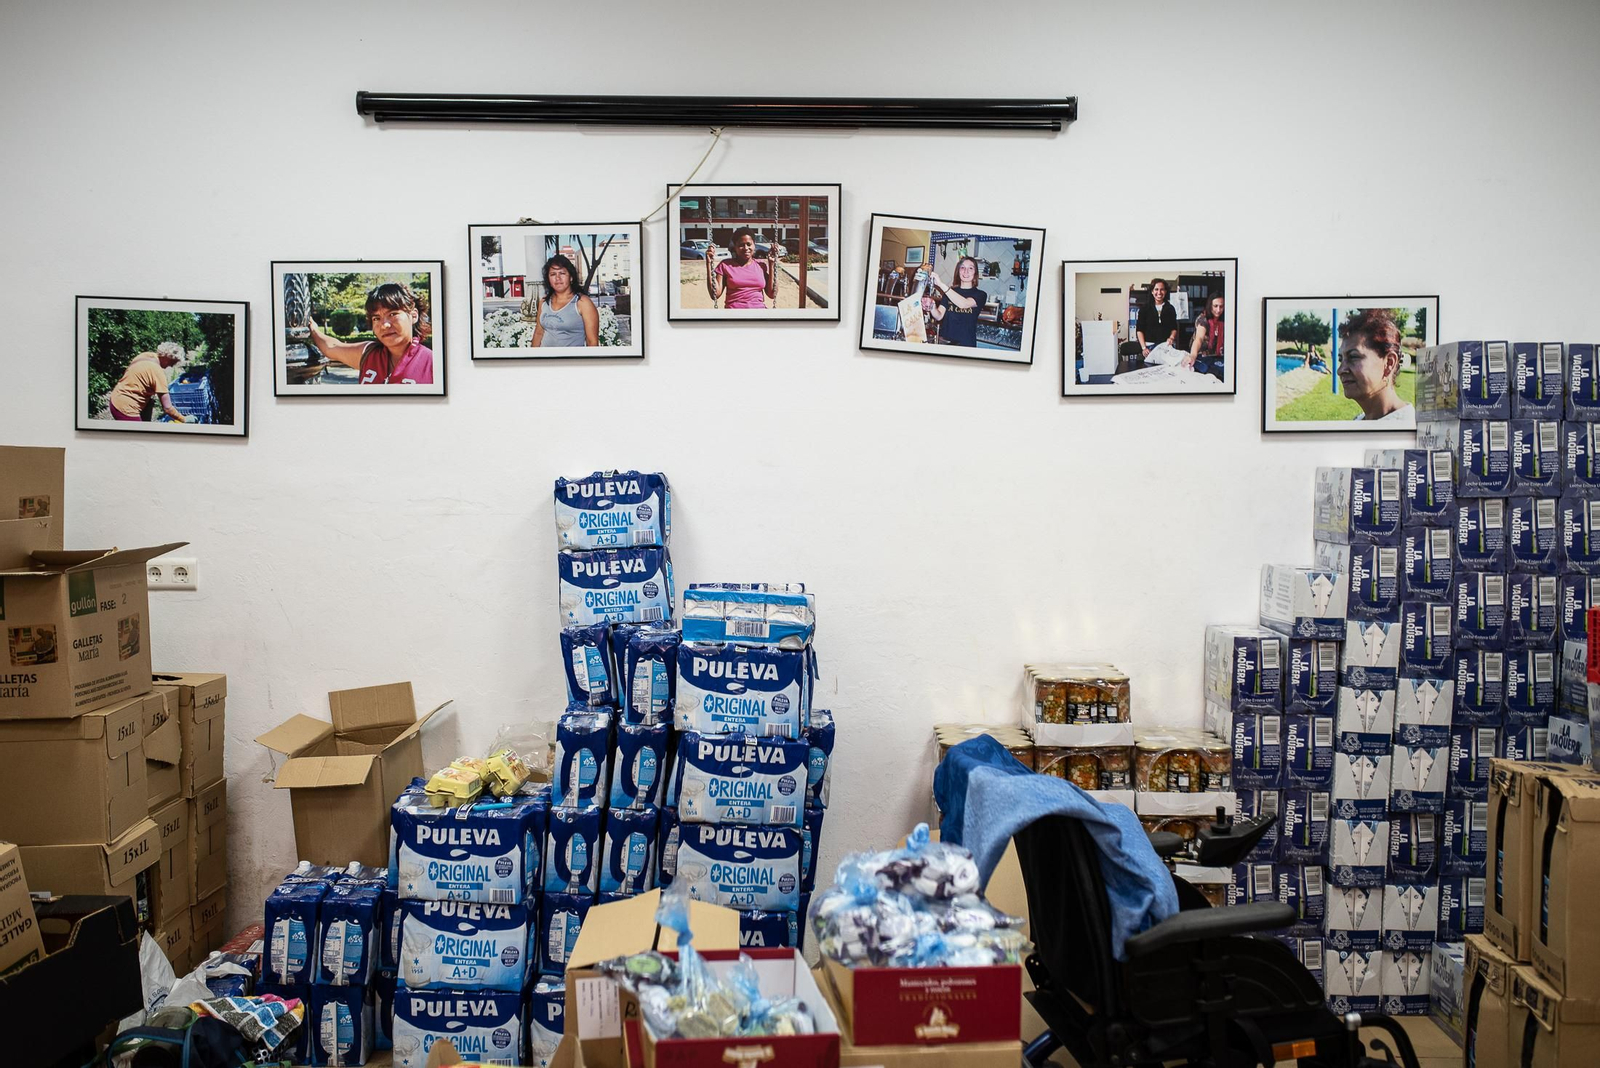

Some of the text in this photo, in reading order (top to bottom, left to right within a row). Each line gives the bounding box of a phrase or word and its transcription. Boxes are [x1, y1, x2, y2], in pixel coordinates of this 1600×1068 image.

[1462, 352, 1471, 389] VAQUERA
[1471, 366, 1479, 375] LA
[1517, 353, 1526, 391] VAQUERA
[1526, 367, 1534, 377] LA
[1572, 355, 1582, 391] VAQUERA
[1581, 368, 1589, 378] LA
[1463, 429, 1472, 467] VAQUERA
[1472, 443, 1480, 453] LA
[1513, 430, 1523, 468] VAQUERA
[1522, 444, 1531, 454] LA
[1567, 431, 1576, 469] VAQUERA
[1576, 445, 1584, 455] LA
[1408, 460, 1417, 498] VAQUERA
[1416, 474, 1424, 484] LA
[566, 480, 641, 498] PULEVA
[1353, 479, 1363, 516] VAQUERA
[1362, 492, 1371, 502] LA
[578, 512, 634, 529] ORIGINAL
[1459, 506, 1468, 544] VAQUERA
[1468, 520, 1476, 530] LA
[1512, 507, 1521, 545] VAQUERA
[1521, 521, 1529, 531] LA
[1564, 509, 1573, 547] VAQUERA
[1572, 523, 1581, 533] LA
[596, 534, 618, 545] A+D
[1405, 537, 1414, 573] VAQUERA
[1414, 550, 1422, 560] LA
[571, 557, 647, 578] PULEVA
[1352, 555, 1362, 592] VAQUERA
[1361, 569, 1370, 579] LA
[71, 595, 96, 614] gullón
[122, 593, 127, 604] 2
[585, 589, 641, 608] ORIGINAL
[1458, 583, 1467, 620] VAQUERA
[1467, 597, 1475, 606] LA
[1512, 584, 1521, 621] VAQUERA
[1521, 598, 1529, 607] LA
[1565, 586, 1574, 623] VAQUERA
[1574, 600, 1582, 610] LA
[604, 612, 624, 622] A+D
[1406, 612, 1415, 650] VAQUERA
[1415, 625, 1423, 636] LA
[73, 634, 103, 649] GALLETAS
[692, 656, 779, 681] PULEVA
[1237, 646, 1247, 684] VAQUERA
[1246, 661, 1254, 670] LA
[1291, 648, 1301, 685] VAQUERA
[1300, 661, 1309, 671] LA
[1457, 659, 1467, 696] VAQUERA
[1466, 673, 1475, 683] LA
[1509, 659, 1518, 697] VAQUERA
[1516, 673, 1525, 683] LA
[703, 693, 767, 717] ORIGINAL
[117, 721, 135, 741] 15x1L
[722, 723, 747, 732] A+D
[1562, 724, 1570, 737] LA
[1234, 722, 1244, 760] VAQUERA
[1244, 736, 1252, 746] LA
[1287, 724, 1297, 761] VAQUERA
[1296, 738, 1304, 748] LA
[1507, 736, 1516, 761] VAQU
[698, 741, 787, 764] PULEVA
[1451, 735, 1461, 771] VAQUERA
[1460, 749, 1468, 759] LA
[1514, 749, 1523, 759] LA
[708, 777, 773, 800] ORIGINAL
[204, 797, 219, 816] 15x1L
[726, 807, 752, 819] A+D
[1233, 798, 1243, 826] VAQUE
[163, 817, 181, 838] 15x1L
[1284, 800, 1296, 836] VAQUERA
[1294, 814, 1303, 823] LA
[416, 824, 501, 846] PULEVA
[699, 825, 787, 849] PULEVA
[1391, 819, 1400, 856] VAQUERA
[1444, 810, 1454, 847] VAQUERA
[1453, 823, 1461, 834] LA
[1399, 833, 1408, 844] LA
[123, 839, 149, 865] 15x1L
[428, 861, 491, 882] ORIGINAL
[710, 863, 775, 886] ORIGINAL
[446, 889, 471, 900] A+D
[730, 893, 755, 904] A+D
[1236, 887, 1244, 897] LA
[1287, 887, 1296, 897] LA
[424, 901, 511, 920] PULEVA
[1450, 898, 1459, 908] LA
[434, 933, 499, 958] ORIGINAL
[452, 967, 477, 978] A+D
[411, 998, 498, 1017] PULEVA
